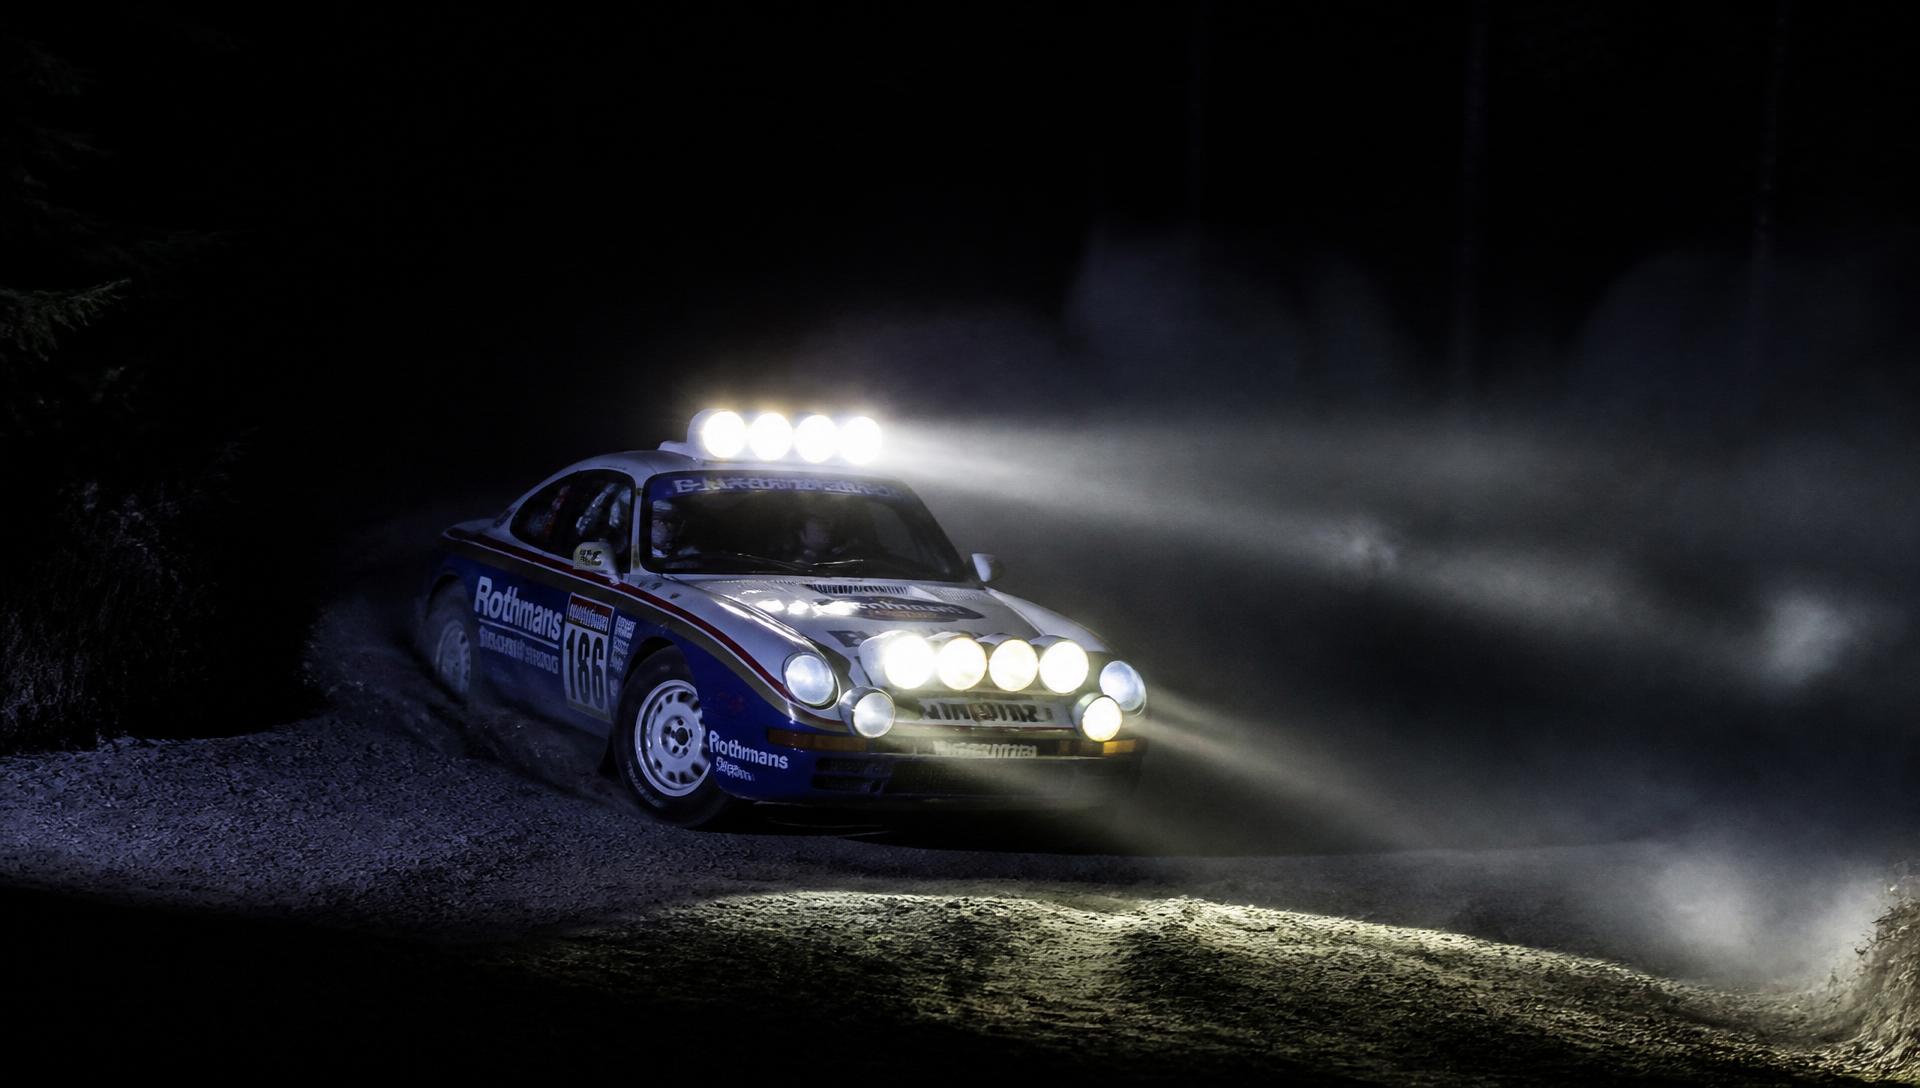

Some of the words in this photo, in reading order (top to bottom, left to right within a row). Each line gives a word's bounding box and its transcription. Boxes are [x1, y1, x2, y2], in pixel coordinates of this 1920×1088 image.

[474, 576, 563, 641] Rothmans
[566, 629, 605, 709] 186
[709, 730, 788, 769] Rothmans
